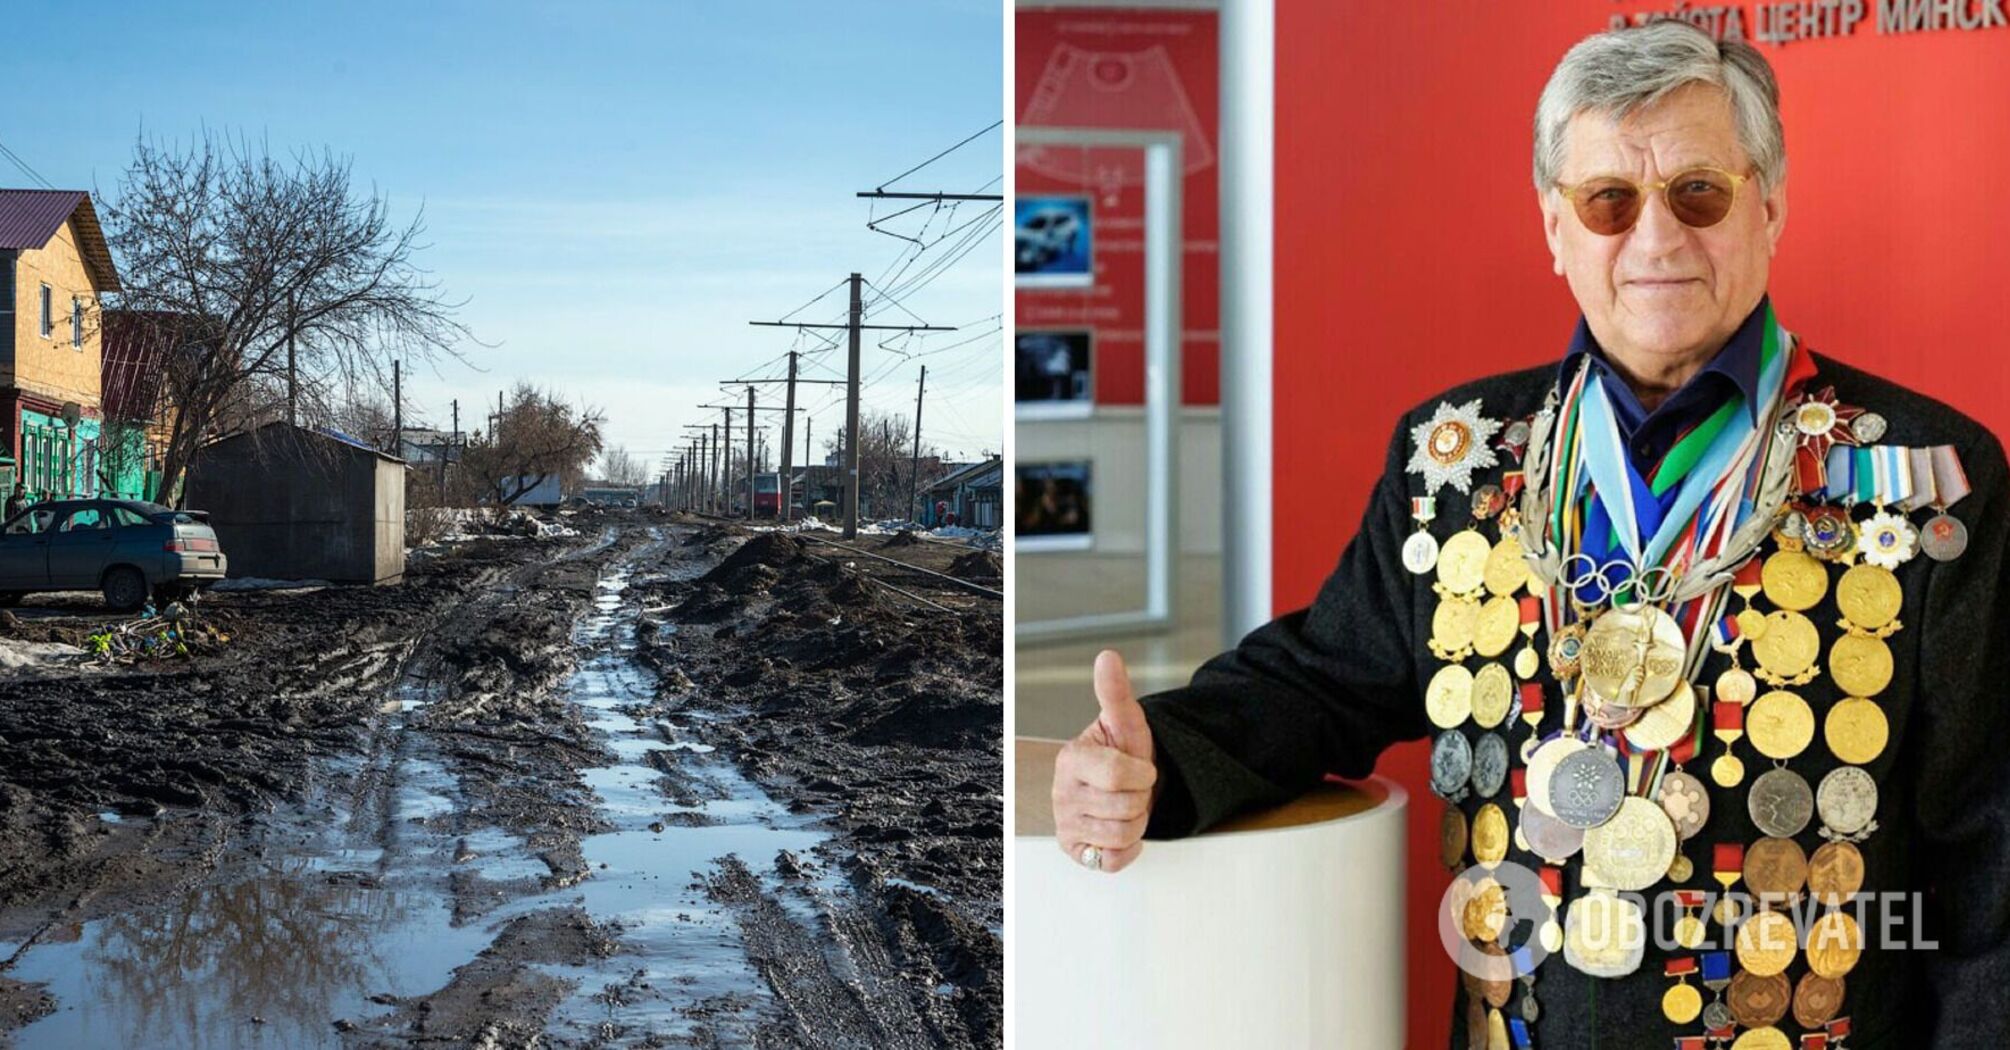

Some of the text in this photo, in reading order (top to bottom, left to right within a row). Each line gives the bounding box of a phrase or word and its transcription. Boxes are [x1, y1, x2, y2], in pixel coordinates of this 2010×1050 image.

[1635, 2, 1745, 44] ОТА
[1754, 0, 1862, 46] ЦЕНТР
[1876, 0, 2006, 34] МИНСК
